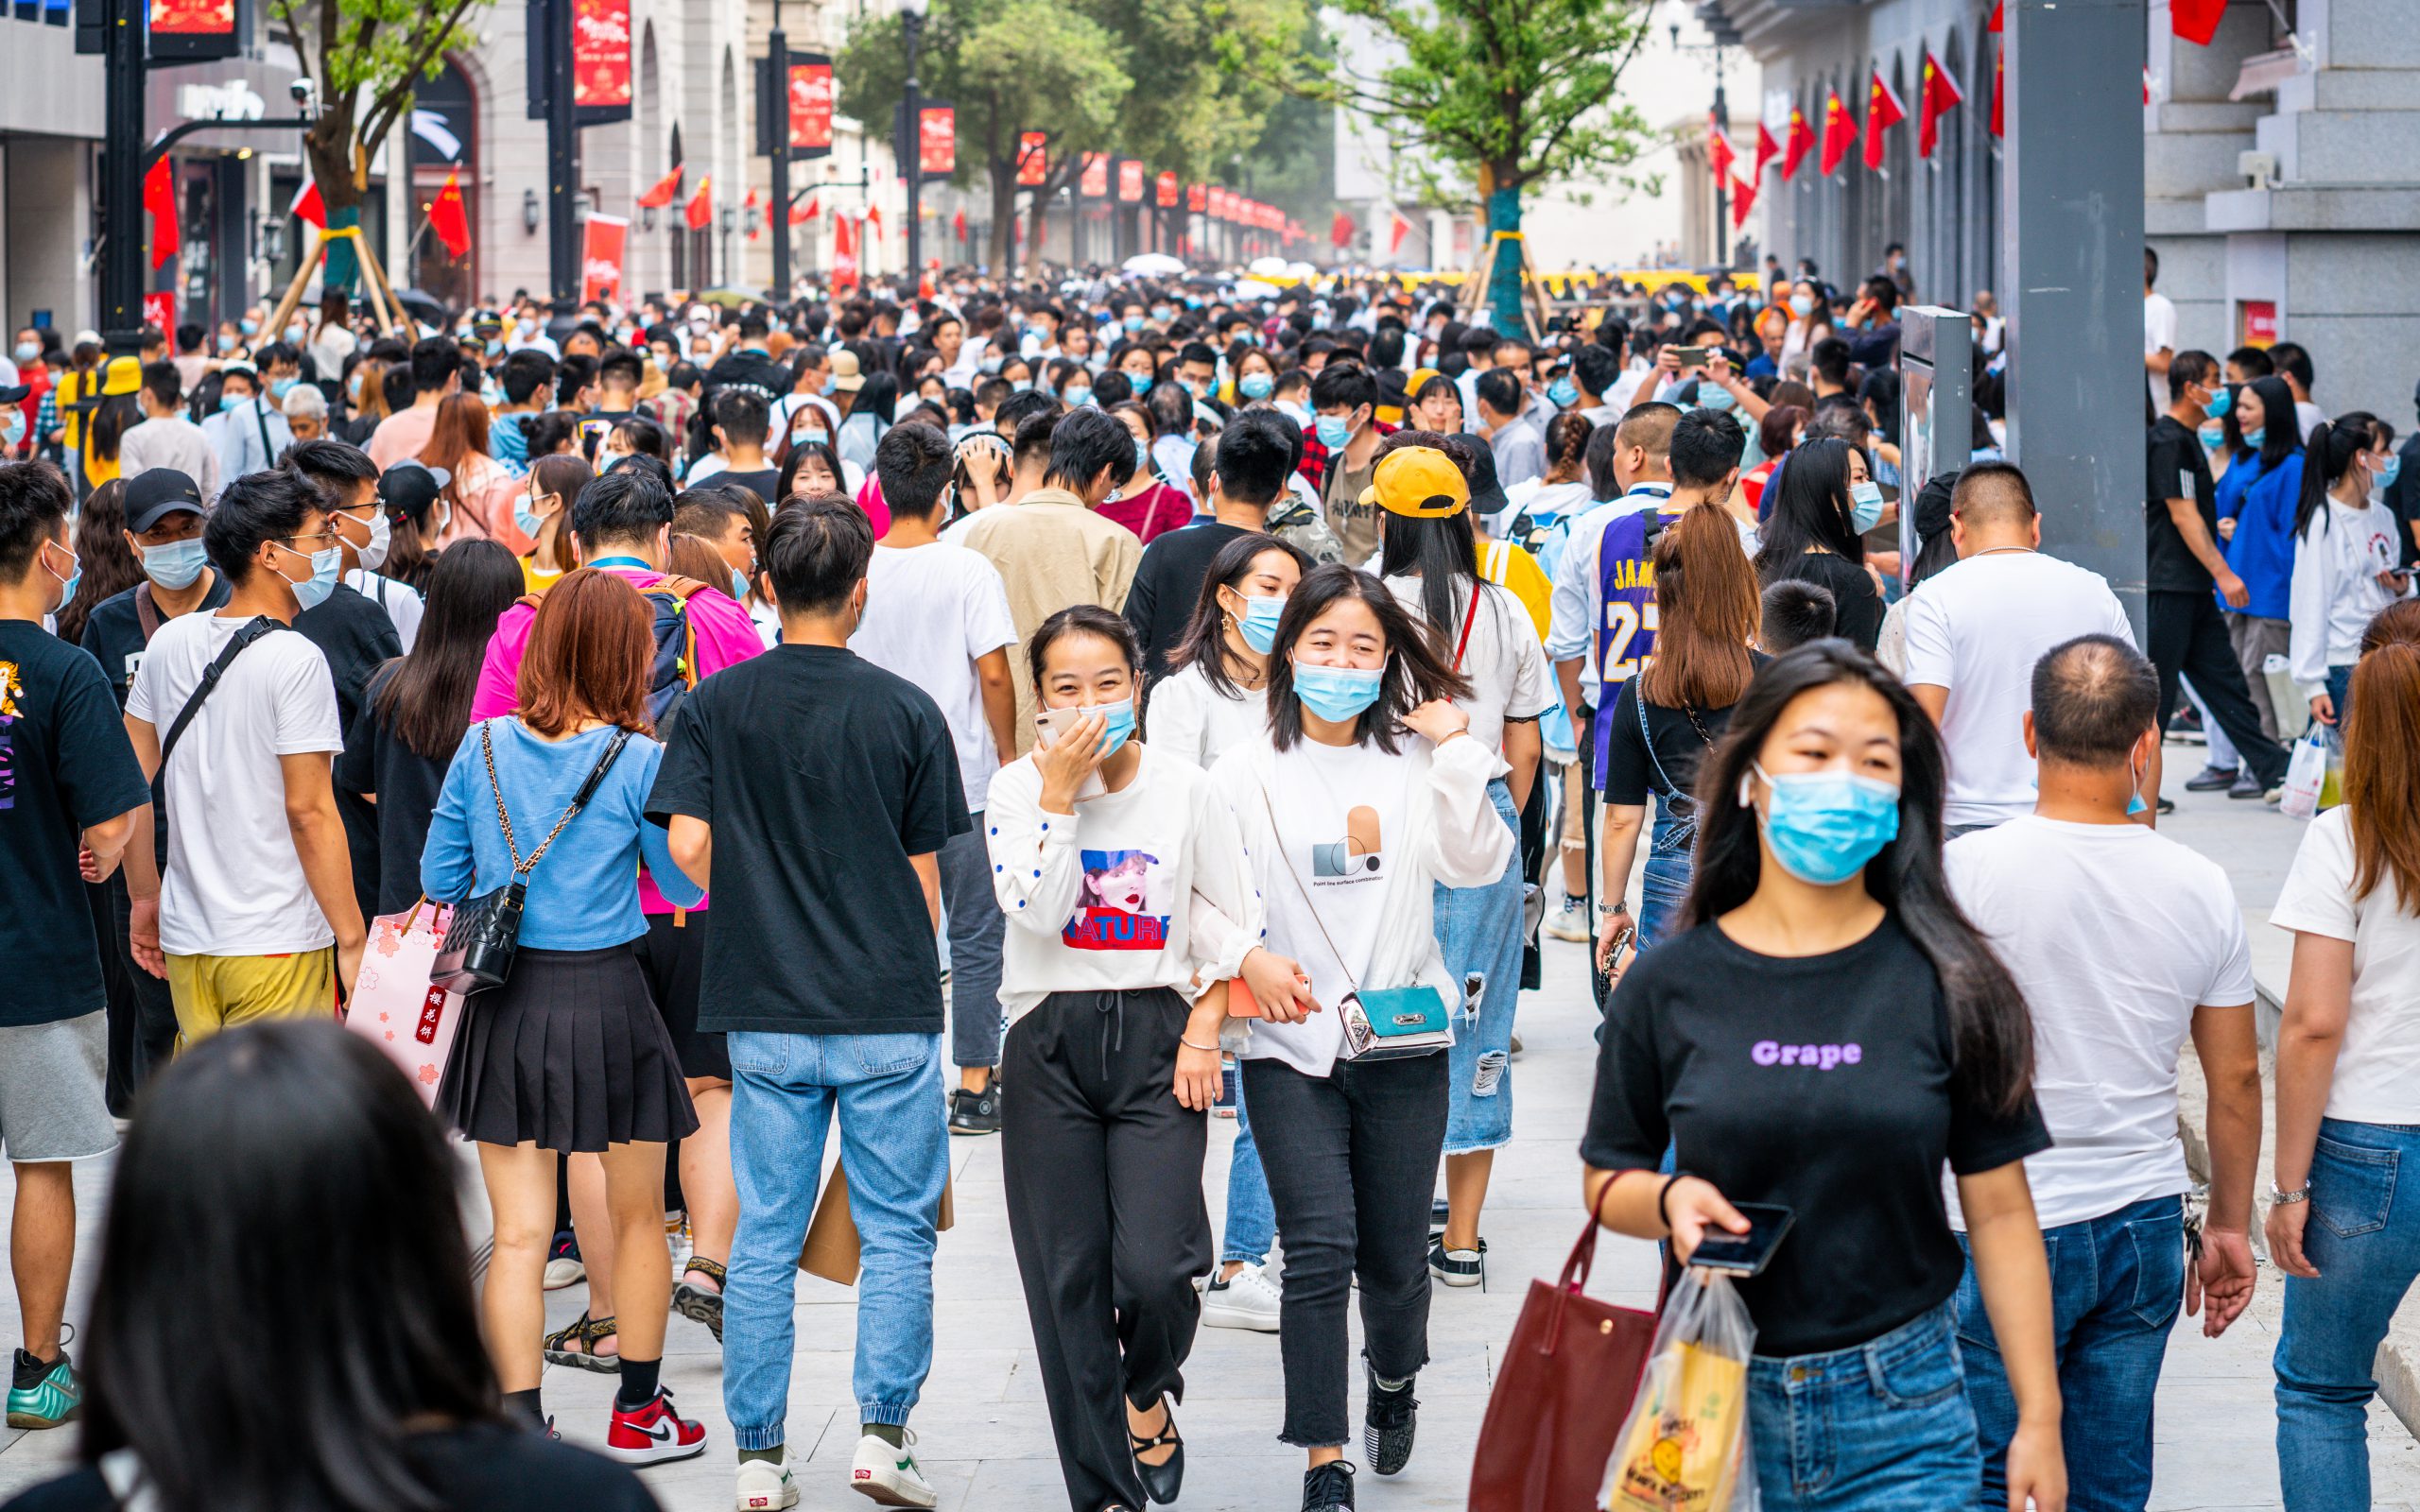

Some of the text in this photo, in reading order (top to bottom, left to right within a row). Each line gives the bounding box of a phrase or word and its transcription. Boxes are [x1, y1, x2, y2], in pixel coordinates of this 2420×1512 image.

[1614, 558, 1658, 591] JAM
[1355, 875, 1384, 884] combination
[1752, 1040, 1862, 1071] Grape
